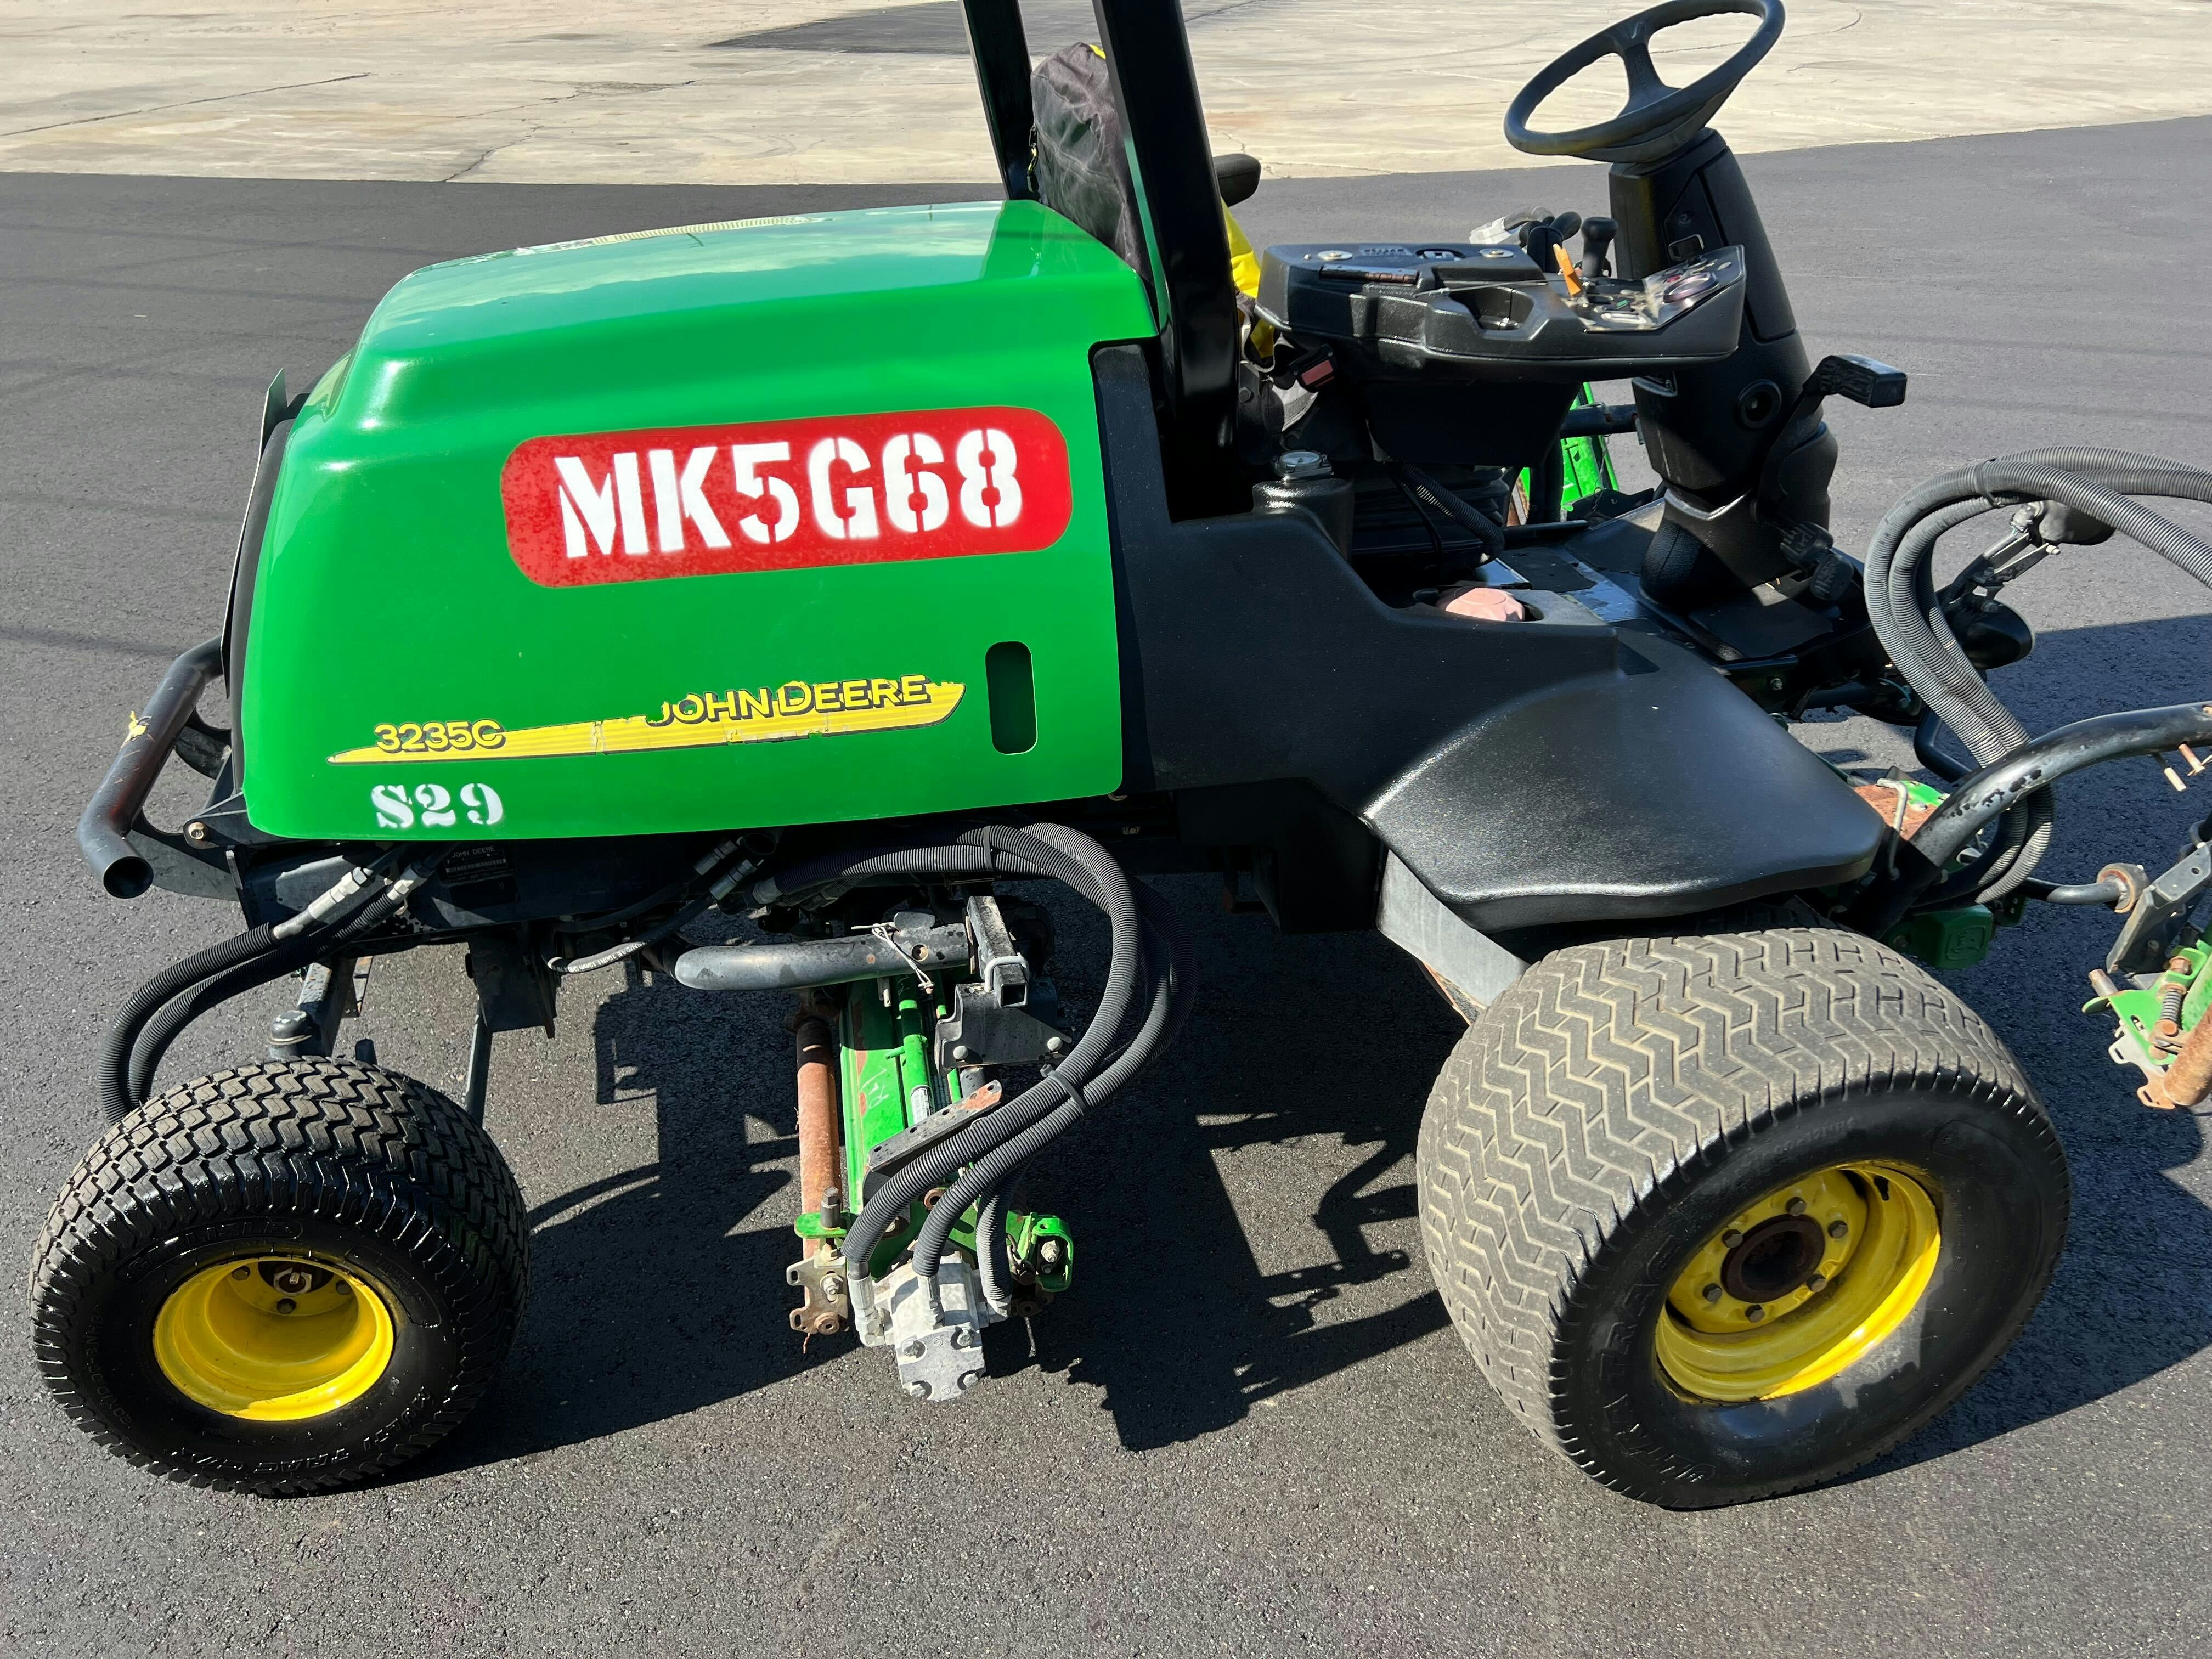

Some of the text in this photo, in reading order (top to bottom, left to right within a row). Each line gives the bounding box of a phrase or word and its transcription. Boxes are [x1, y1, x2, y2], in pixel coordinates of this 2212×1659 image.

[554, 428, 1022, 558] MK5G68
[645, 674, 931, 727] JOHN DEERE
[374, 719, 506, 753] 3235C
[371, 783, 503, 828] S29
[452, 845, 495, 858] JOHN DEERE
